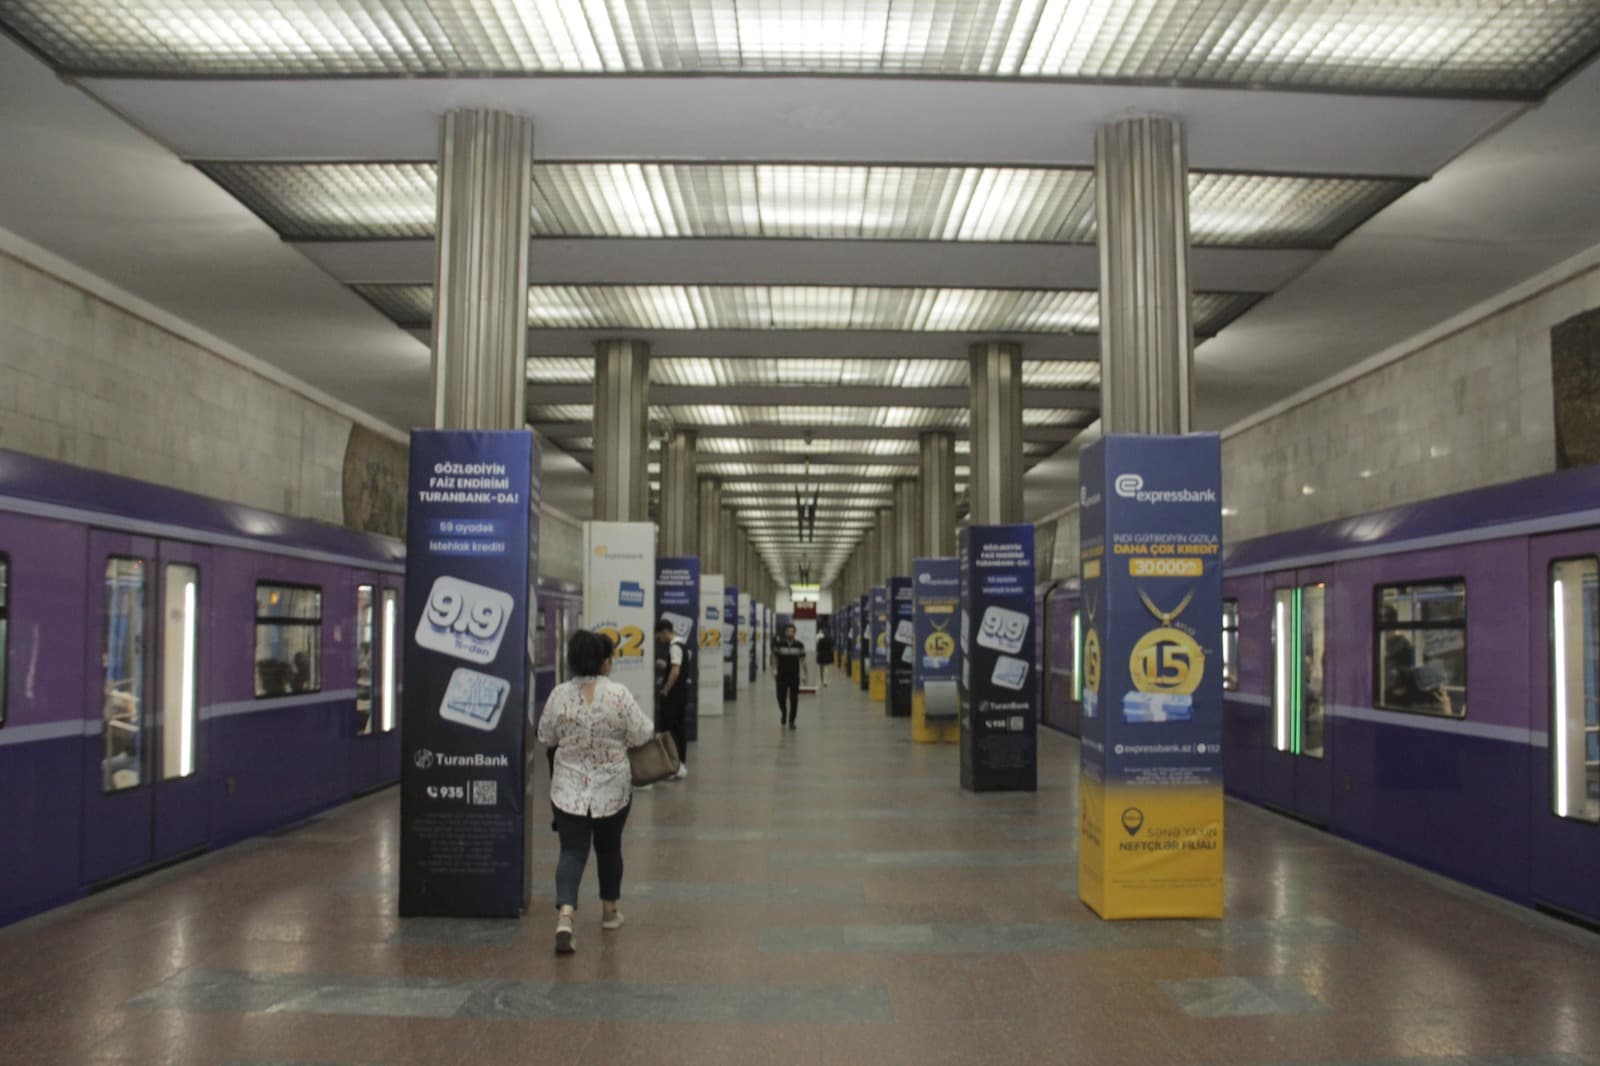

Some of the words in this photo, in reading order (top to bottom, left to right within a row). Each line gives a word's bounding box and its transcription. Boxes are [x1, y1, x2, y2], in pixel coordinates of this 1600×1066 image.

[430, 476, 455, 489] FAİZ
[457, 477, 509, 489] ENDİRİMİ
[1136, 488, 1216, 504] expressbank
[472, 540, 505, 552] krediti
[1113, 544, 1148, 555] DAHA
[1151, 544, 1175, 557] ÇOX
[1140, 645, 1189, 684] 15
[436, 753, 508, 766] TuranBank
[440, 786, 464, 798] 935
